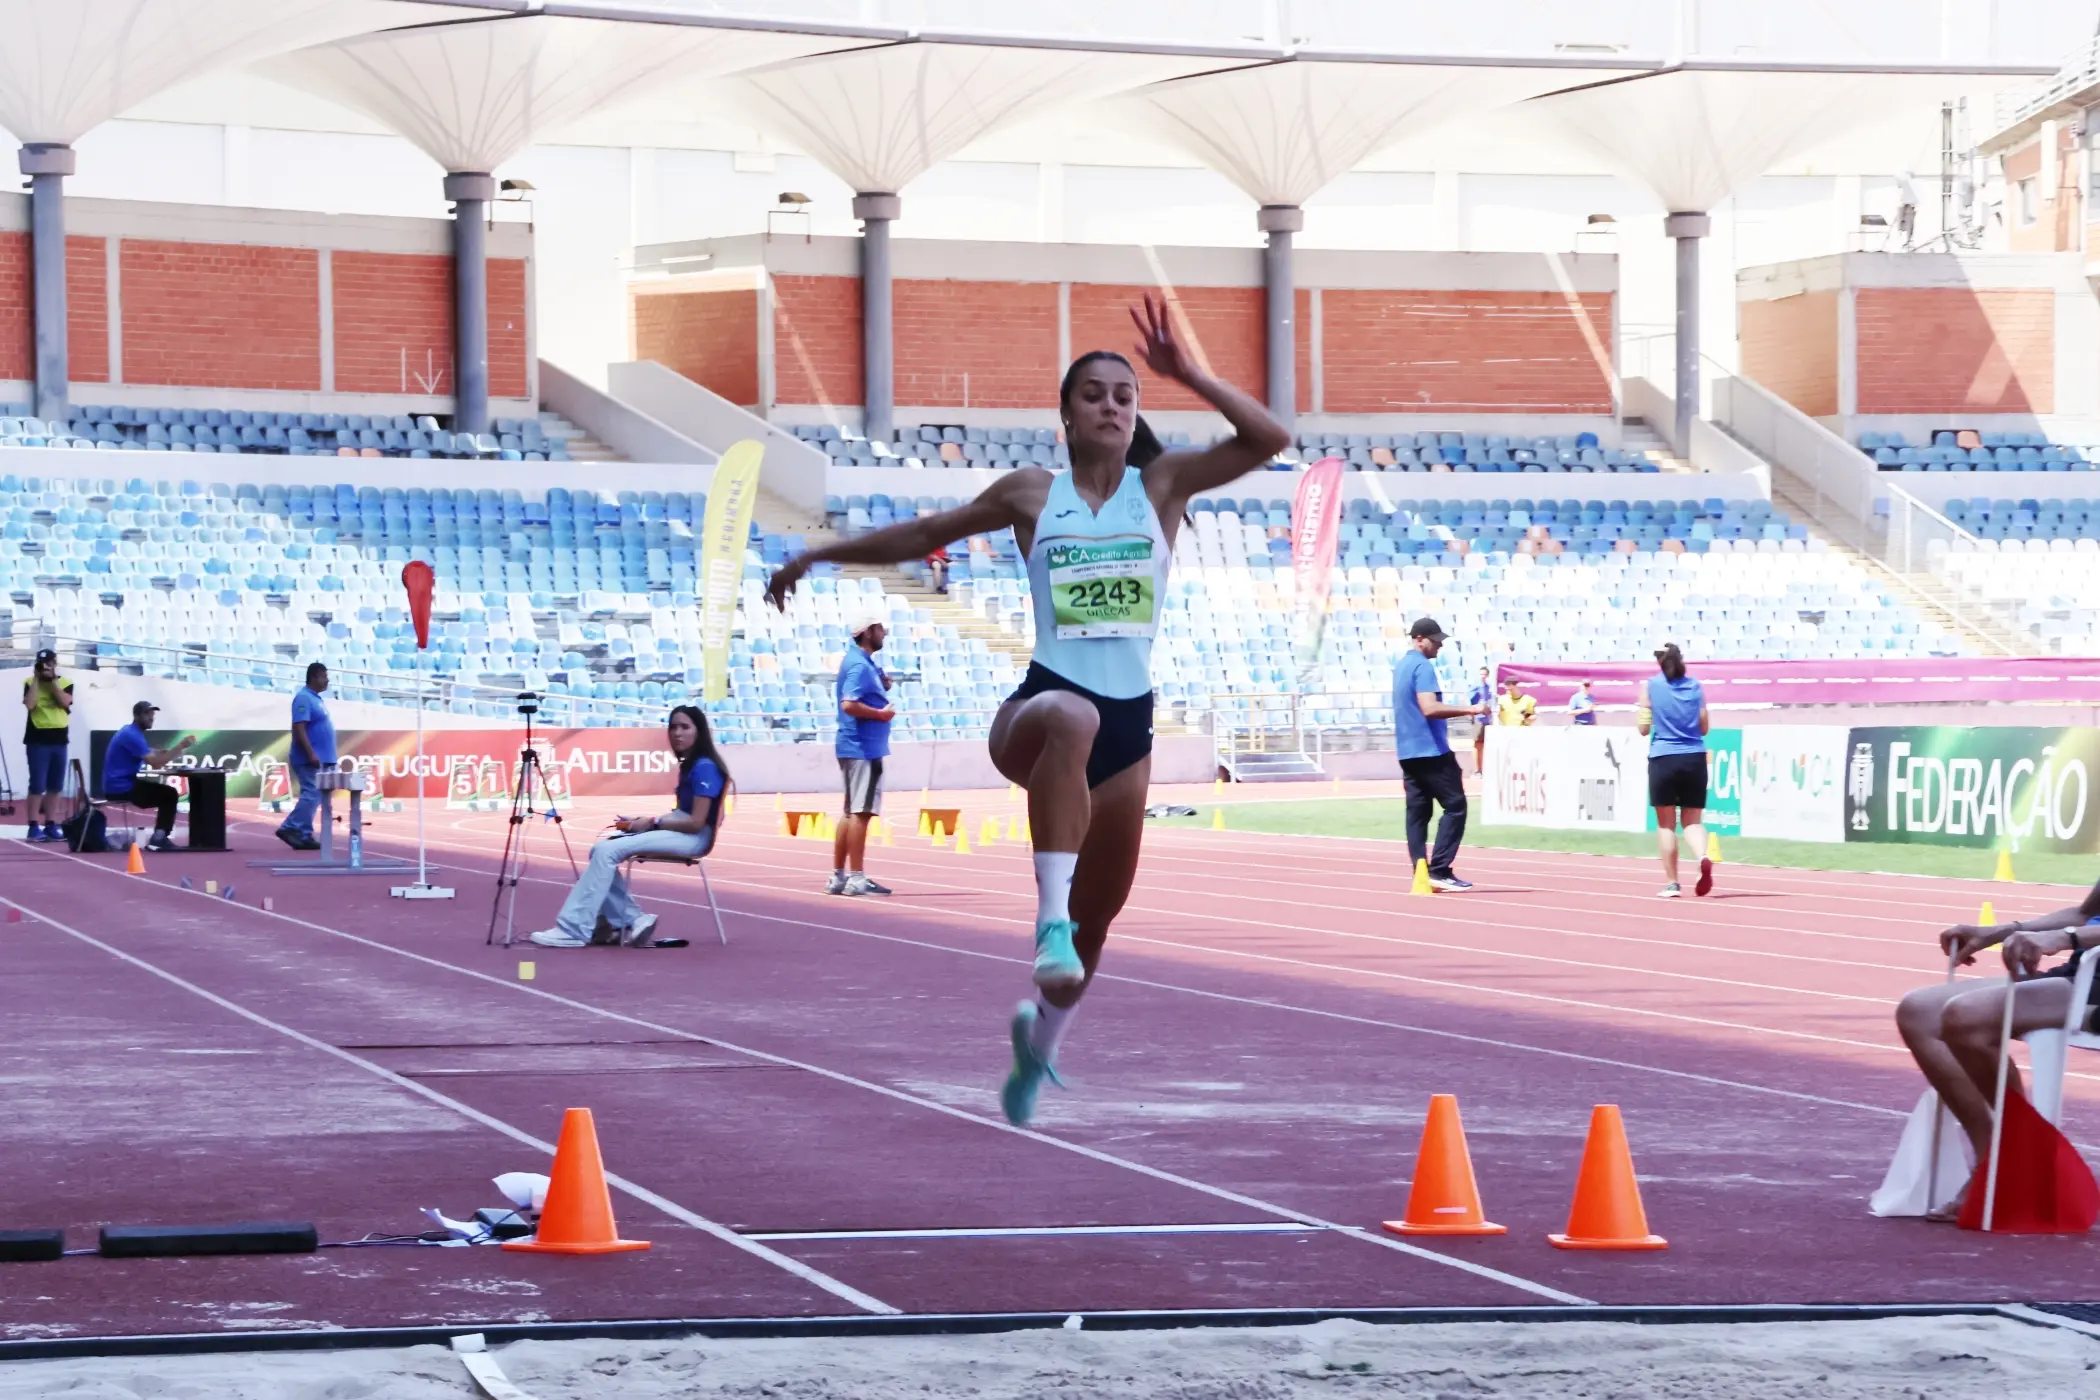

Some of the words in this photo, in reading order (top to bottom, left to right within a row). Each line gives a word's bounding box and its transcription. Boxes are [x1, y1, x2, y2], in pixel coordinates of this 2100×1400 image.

[1069, 549, 1090, 564] CA
[1068, 580, 1141, 608] 2243
[567, 747, 686, 774] ATLETISM
[166, 775, 183, 794] 8
[268, 774, 284, 795] 7
[456, 774, 472, 795] 5
[486, 772, 498, 793] 1
[546, 773, 562, 794] 4
[1714, 749, 1741, 800] CA
[1886, 741, 2088, 854] FEDERAÇÃO
